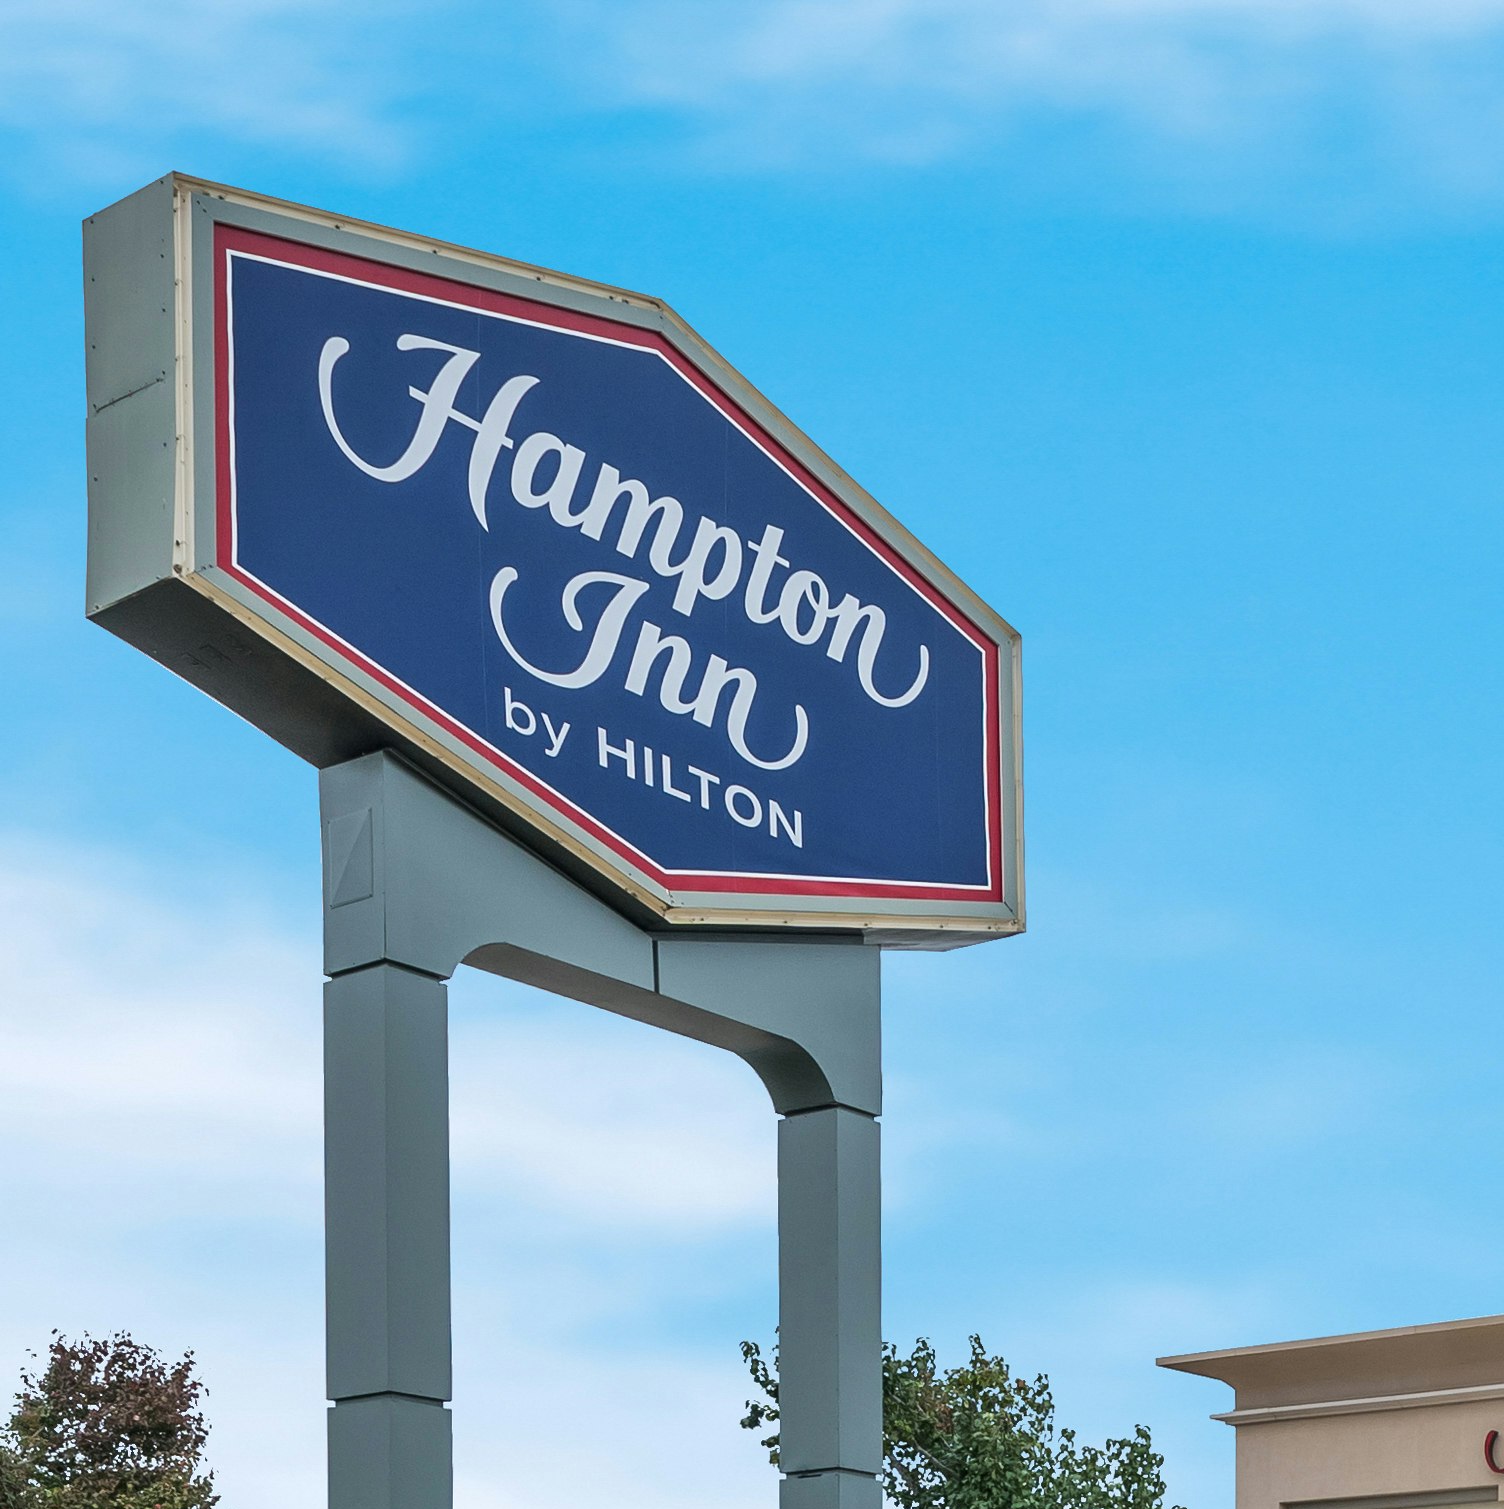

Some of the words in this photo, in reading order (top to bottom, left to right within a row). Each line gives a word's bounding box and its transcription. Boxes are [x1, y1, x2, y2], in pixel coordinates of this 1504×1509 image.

[319, 334, 930, 708] Hampton
[490, 567, 809, 771] Inn
[505, 687, 571, 758] by
[598, 727, 803, 849] HILTON
